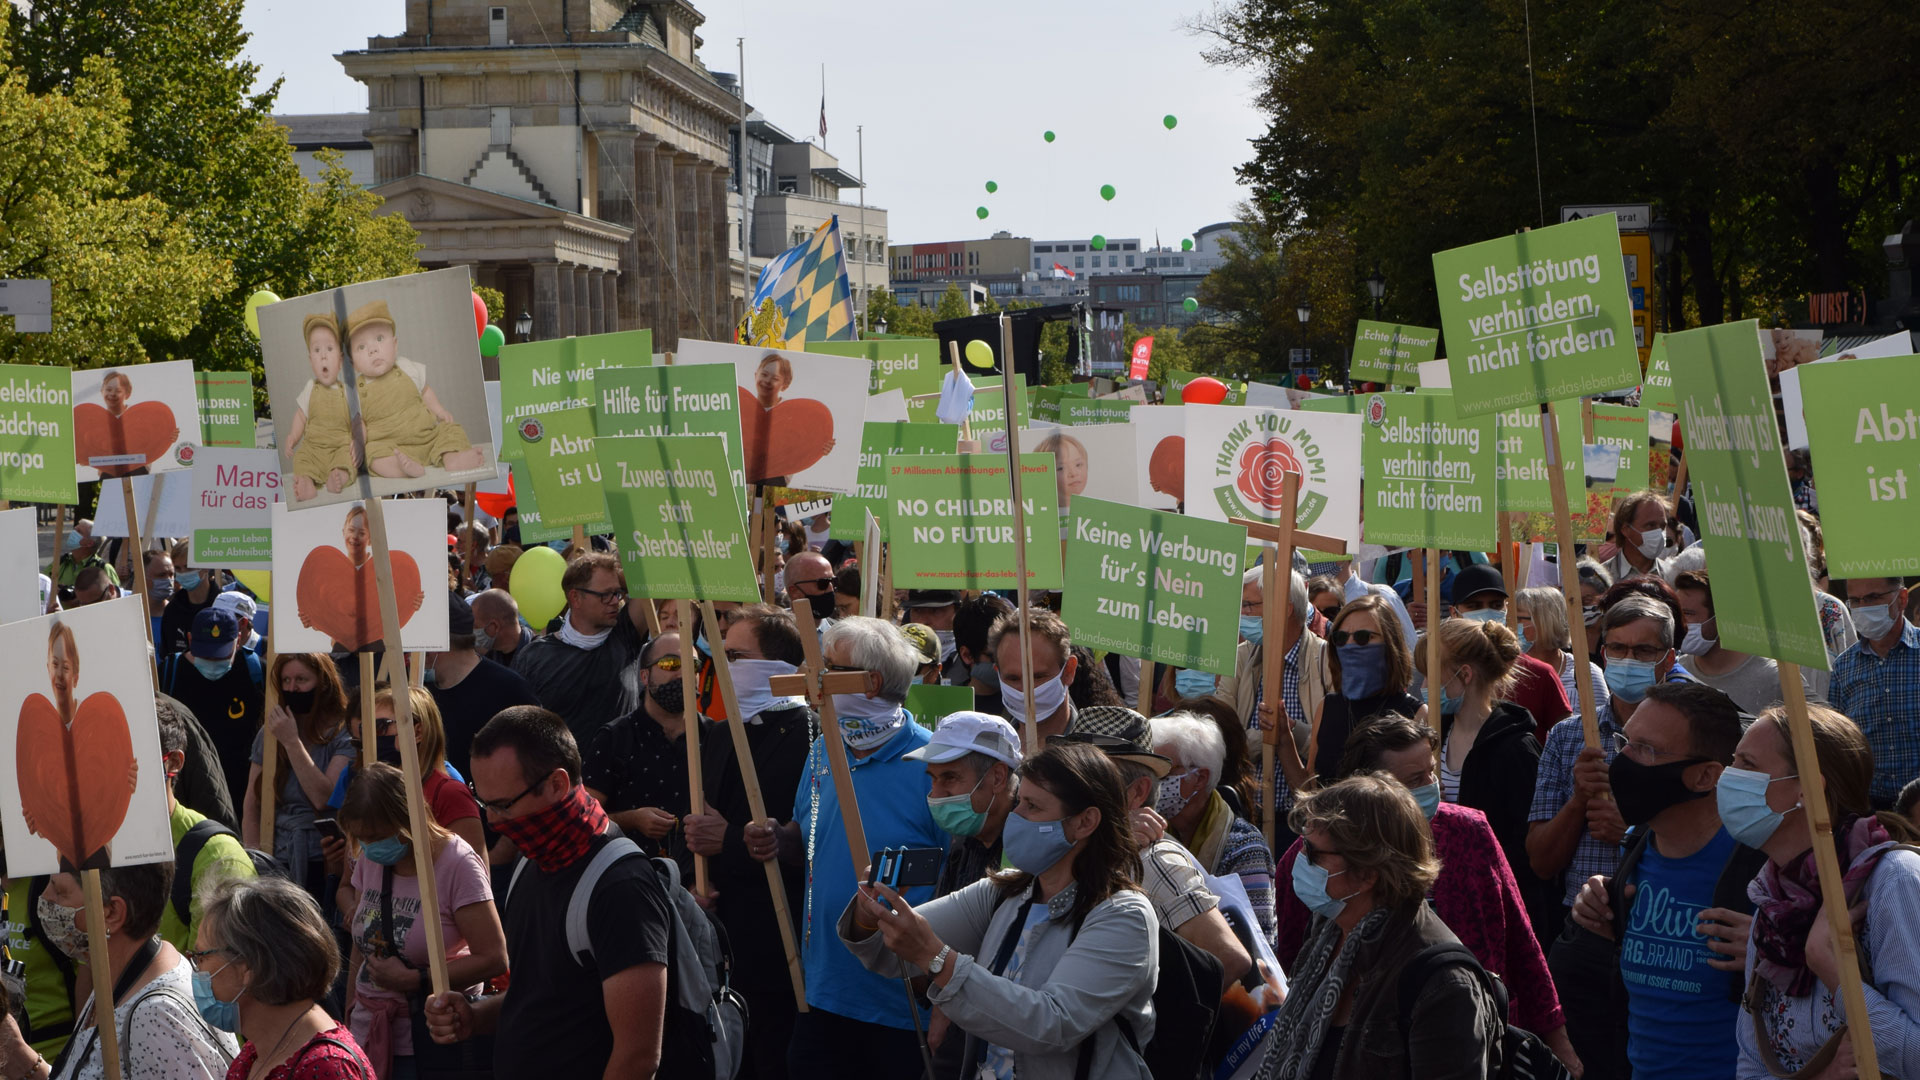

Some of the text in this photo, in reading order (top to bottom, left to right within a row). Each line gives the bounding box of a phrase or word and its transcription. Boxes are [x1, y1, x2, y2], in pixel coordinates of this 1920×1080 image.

[1458, 254, 1601, 302] Selbsttötung
[1468, 291, 1601, 337] verhindern,
[1809, 291, 1849, 325] WURST
[1358, 359, 1371, 368] zu
[1373, 359, 1401, 371] ihrem
[1378, 346, 1411, 359] stehen
[1467, 324, 1616, 374] nicht fördern
[532, 367, 561, 387] Nie
[603, 385, 732, 415] Hilfe für Frauen
[1070, 406, 1130, 419] Selbsttötung
[1380, 415, 1480, 455] Selbsttötung
[1684, 393, 1775, 469] Abtreibung ist
[1854, 403, 1920, 444] Abt
[550, 434, 595, 457] Abtr
[1216, 414, 1327, 483] THANK YOU MOM!
[0, 451, 44, 475] ropa
[558, 467, 581, 487] ist
[617, 458, 718, 498] Zuwendung
[891, 467, 901, 475] 57
[903, 466, 942, 475] Millionen
[944, 466, 1006, 477] Abtreibungen
[1383, 449, 1476, 484] verhindern,
[201, 490, 268, 509] für das
[1377, 482, 1482, 513] nicht fördern
[1866, 466, 1908, 502] ist
[658, 500, 694, 522] statt
[897, 500, 928, 516] NO
[1701, 480, 1794, 562] keine Lösung
[209, 534, 219, 544] Ja
[242, 535, 268, 543] Leben
[913, 526, 1032, 544] NO FUTUR!
[1076, 516, 1237, 577] Keine Werbung
[1100, 554, 1204, 599] für’s Nein
[1096, 597, 1209, 635] zum Leben
[1074, 627, 1220, 668] Bundesverband Lebensrecht
[228, 697, 245, 719] ن
[1648, 975, 1671, 989] ISSUE
[1672, 979, 1702, 993] GOODS
[1238, 1038, 1252, 1052] my
[1248, 1017, 1267, 1042] life?
